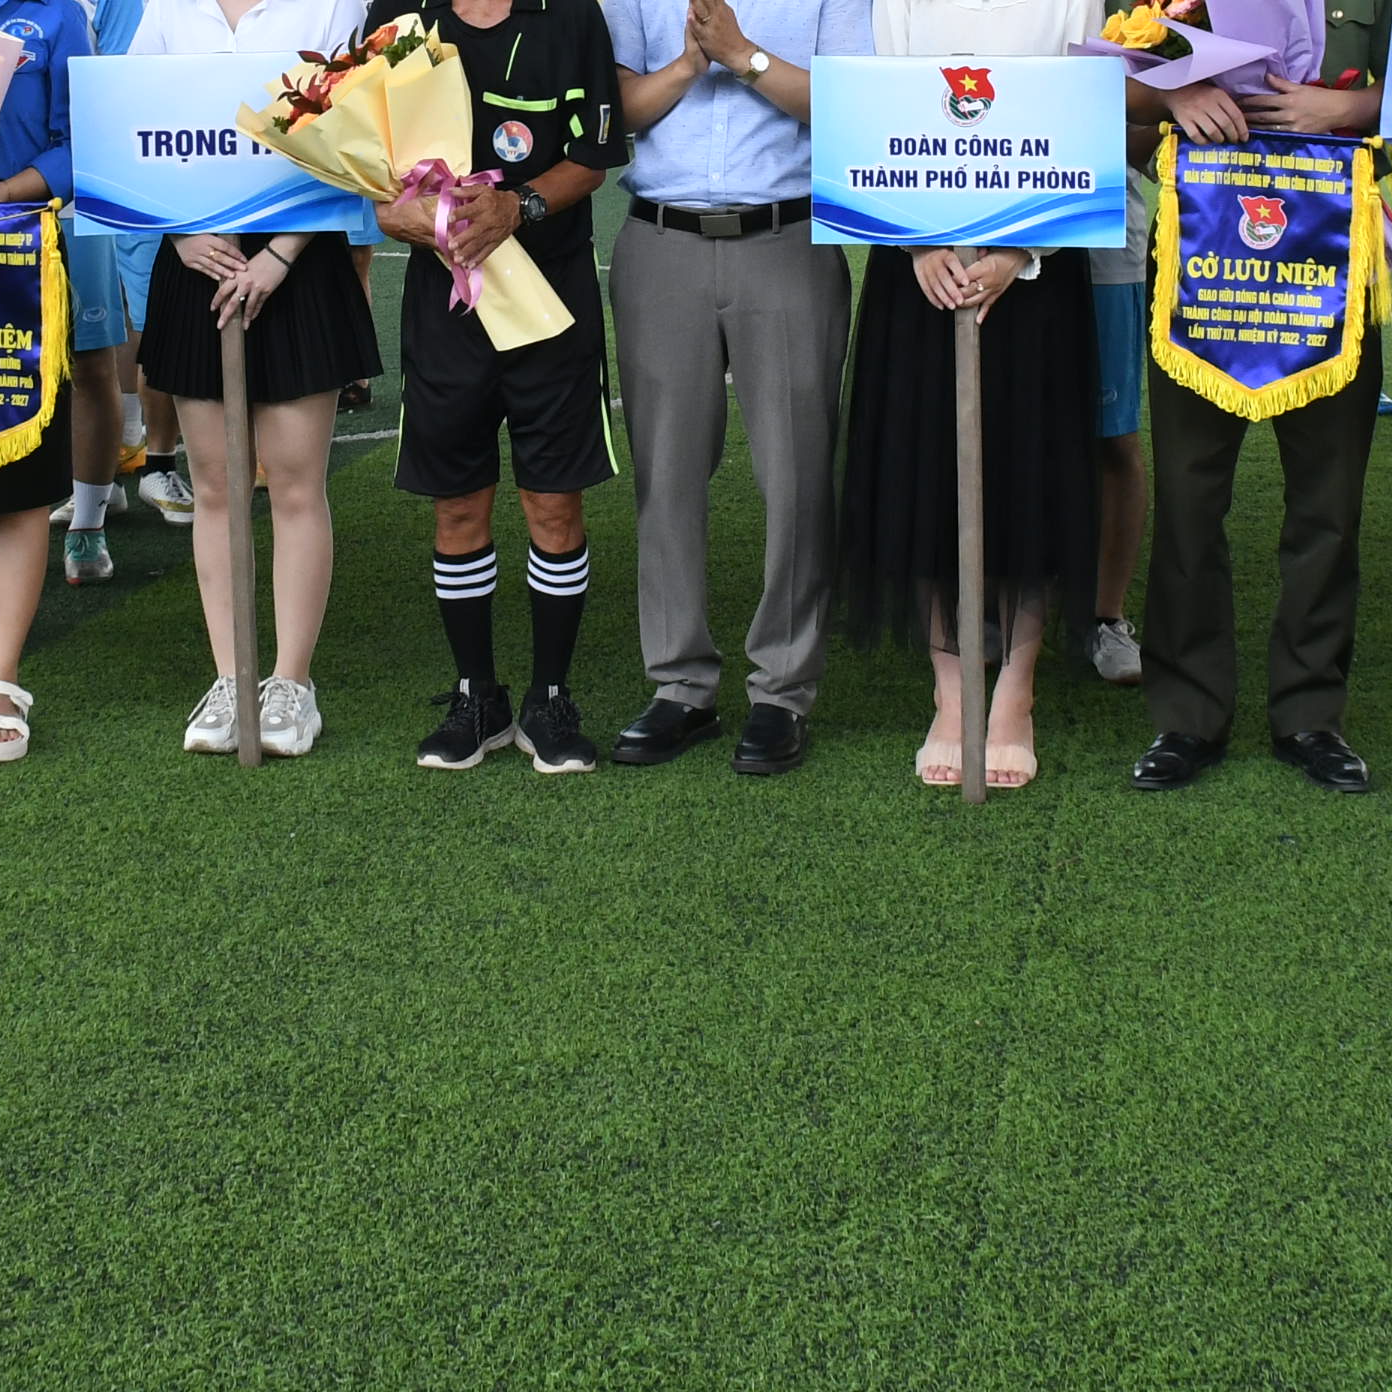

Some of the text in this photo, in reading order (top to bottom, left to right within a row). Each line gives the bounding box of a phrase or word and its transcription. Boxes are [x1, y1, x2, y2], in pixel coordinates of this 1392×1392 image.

[137, 129, 237, 162] TRỌNG
[889, 133, 1050, 156] ĐOÀN CÔNG AN
[850, 163, 1091, 189] THÀNH PHỐ HẢI PHÒNG
[1187, 251, 1336, 290] CỜ LƯU NIỆM
[1198, 289, 1217, 301] GIAO
[1280, 332, 1299, 344] 2022
[1306, 334, 1327, 347] 2027
